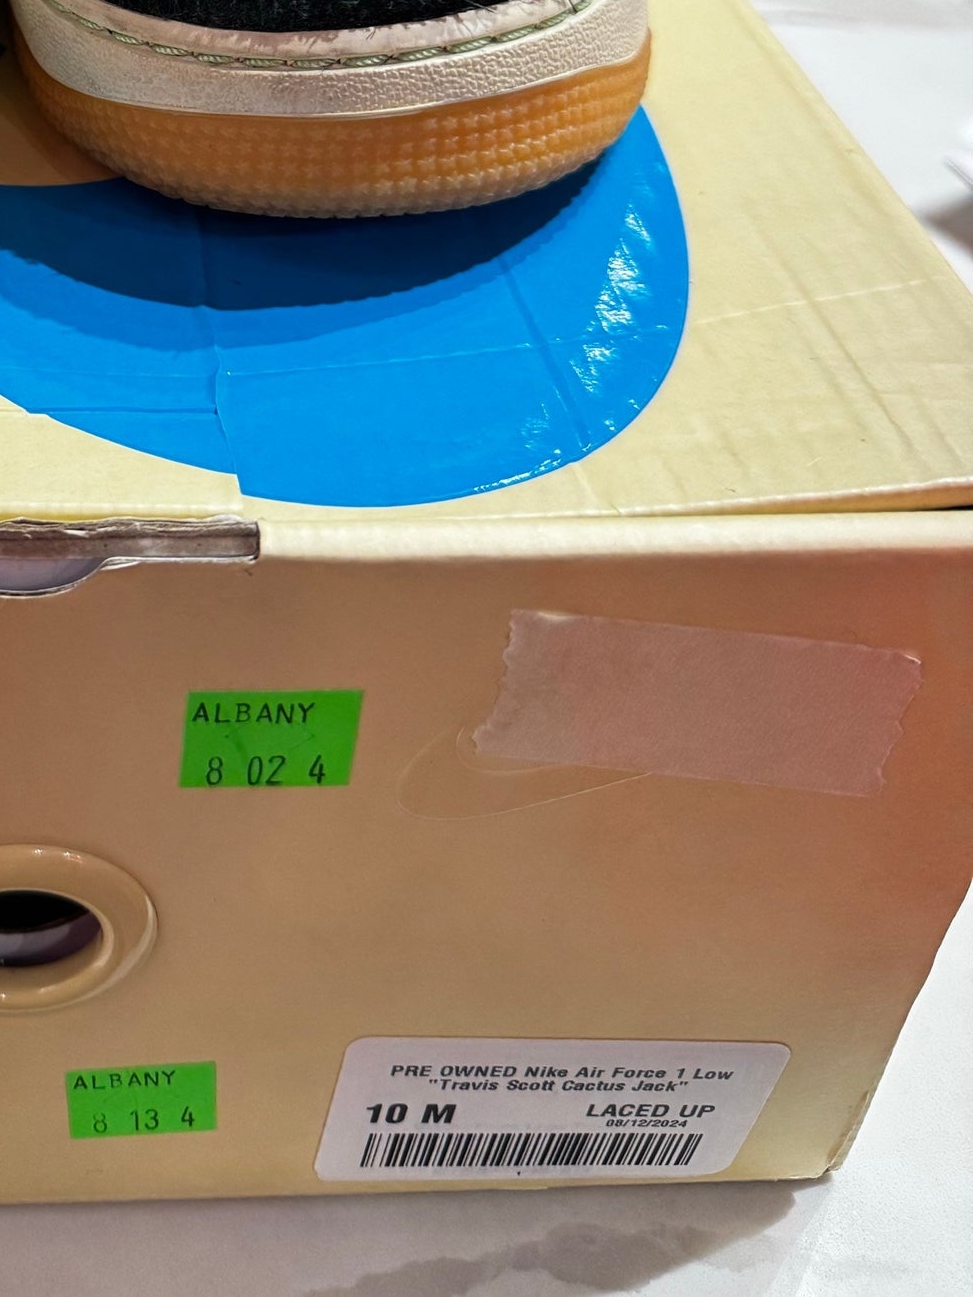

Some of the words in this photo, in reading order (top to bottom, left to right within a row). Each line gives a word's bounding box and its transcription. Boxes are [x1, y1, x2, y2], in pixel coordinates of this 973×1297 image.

[192, 702, 316, 724] ALBANY
[205, 756, 223, 786] 8
[247, 755, 286, 786] 02
[308, 754, 325, 784] 4
[73, 1070, 176, 1090] ALBANY
[390, 1065, 432, 1077] PRE
[440, 1065, 517, 1077] OWNED
[524, 1066, 568, 1078] Nike
[575, 1067, 605, 1078] Air
[611, 1067, 667, 1079] Force
[677, 1068, 686, 1079] 1
[692, 1068, 734, 1080] Low
[429, 1079, 499, 1091] "Travis
[506, 1079, 556, 1091] Scott
[561, 1080, 626, 1092] Cactus
[632, 1080, 688, 1092] Jack"
[92, 1112, 108, 1134] 8
[130, 1108, 159, 1131] 13
[180, 1106, 195, 1127] 4
[366, 1103, 408, 1124] 10
[421, 1103, 457, 1124] M
[585, 1104, 670, 1117] LACED
[678, 1104, 716, 1118] UP
[605, 1119, 688, 1128] 08/12/2024
